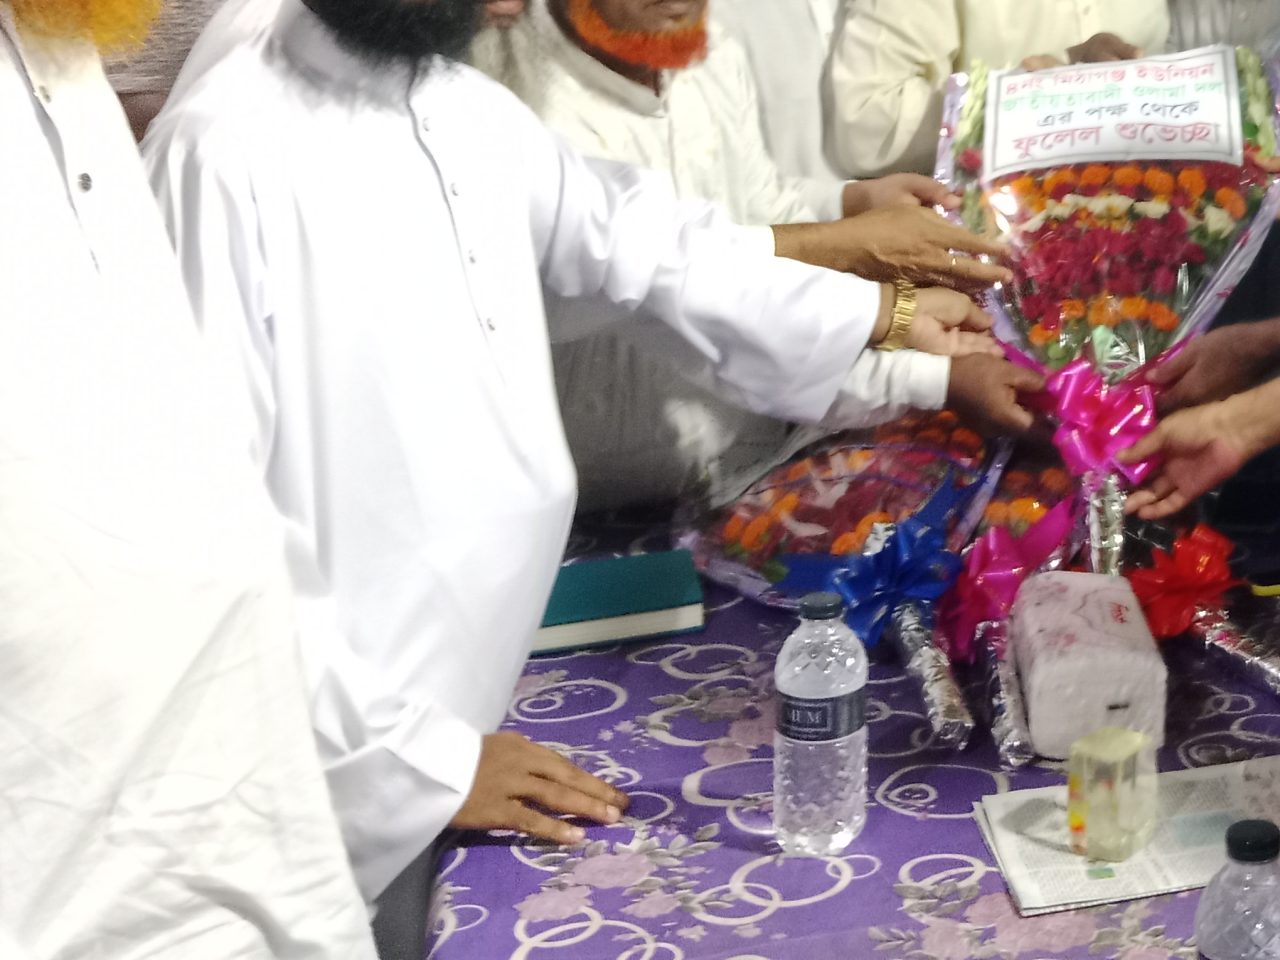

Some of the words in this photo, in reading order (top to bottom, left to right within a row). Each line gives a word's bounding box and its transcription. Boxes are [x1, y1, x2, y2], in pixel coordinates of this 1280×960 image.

[1037, 110, 1075, 128] এর
[1140, 100, 1201, 119] থেকে
[1013, 126, 1104, 159] ফুলেল
[1115, 121, 1221, 146] শুভেচ্ছা
